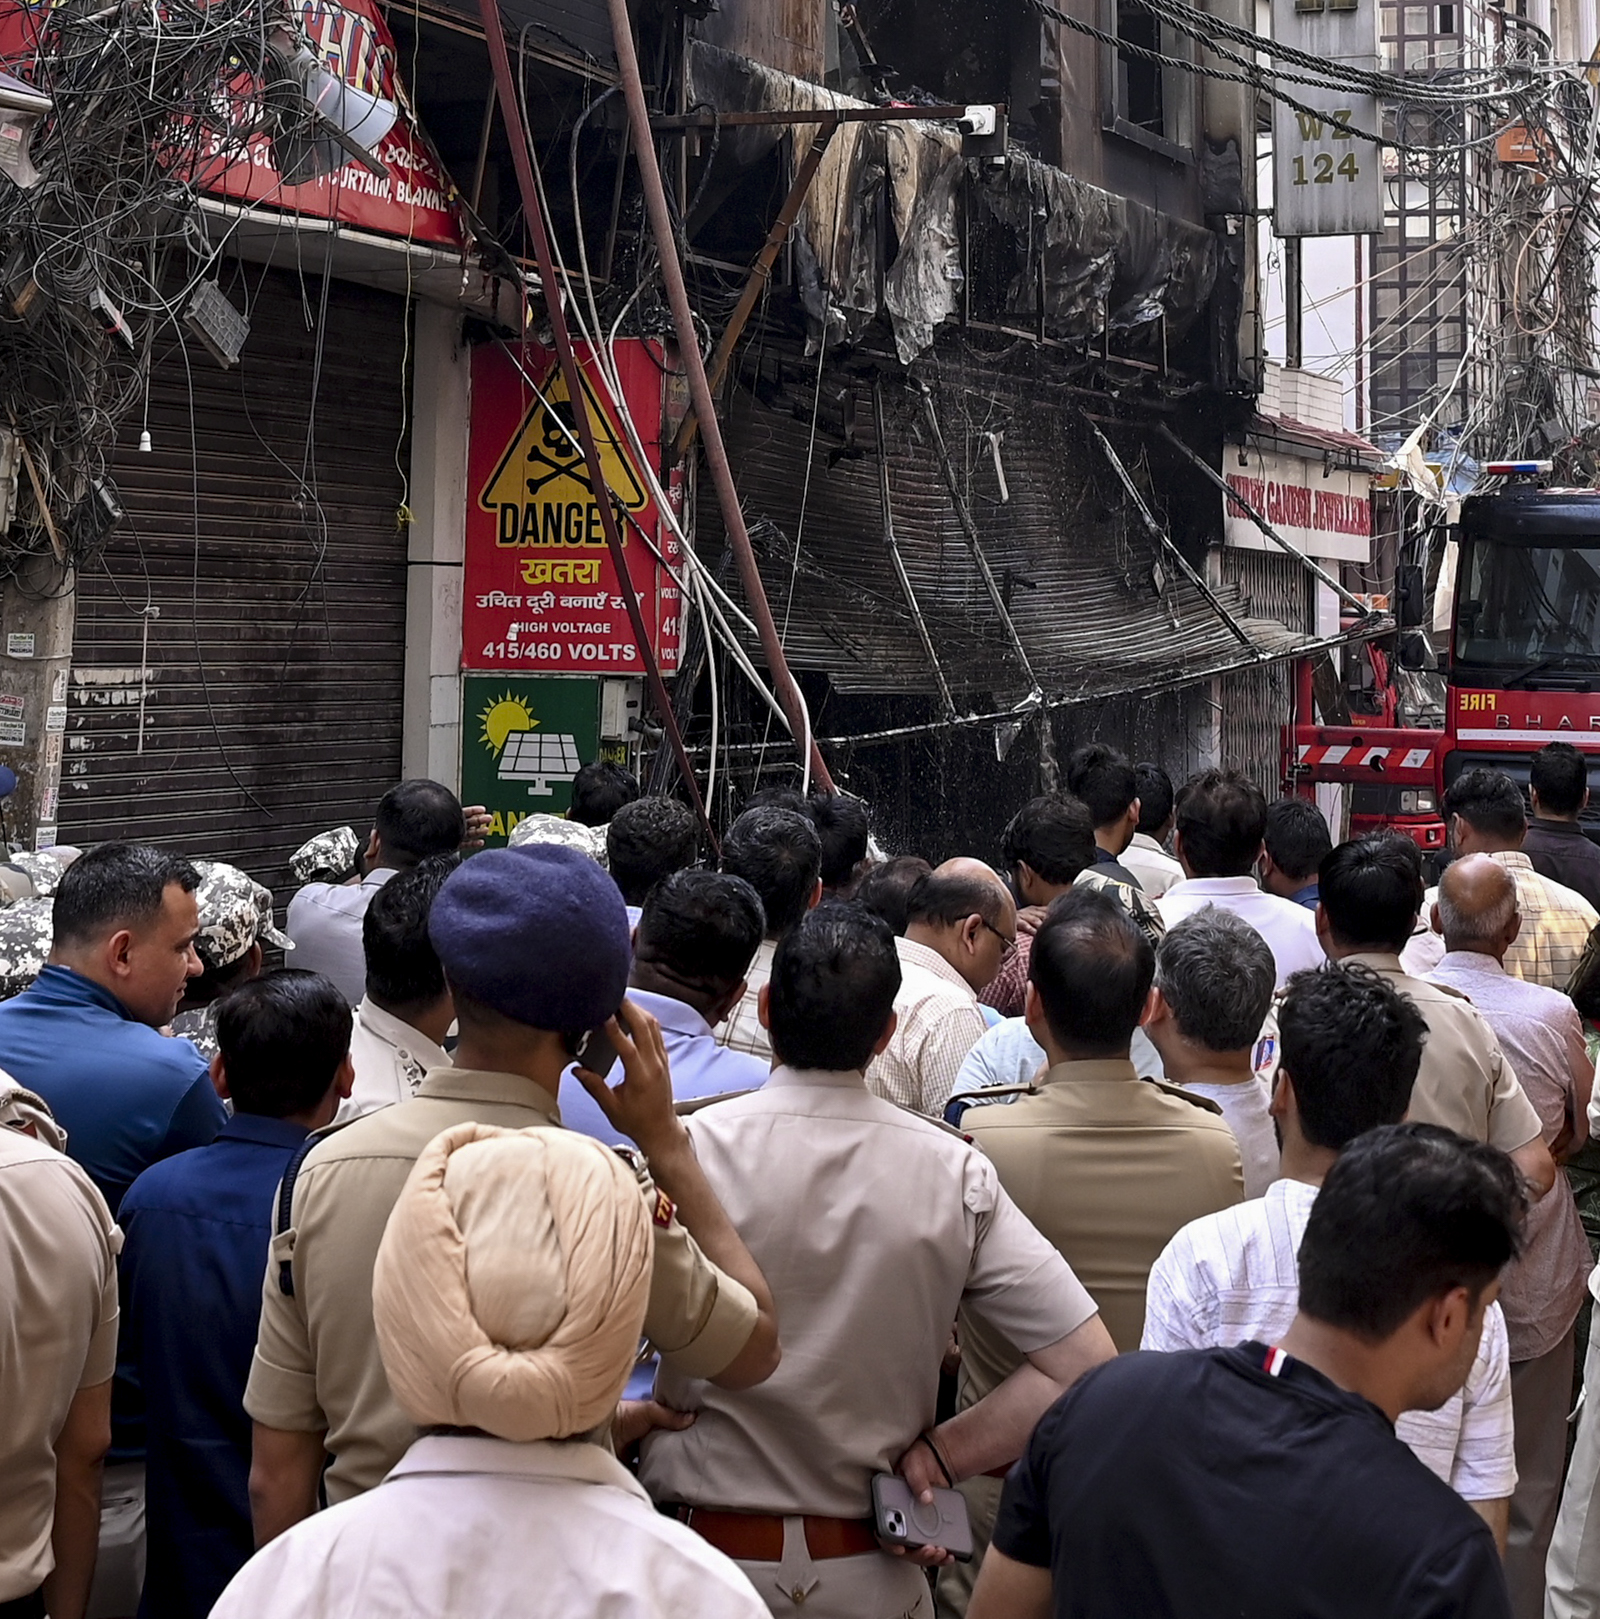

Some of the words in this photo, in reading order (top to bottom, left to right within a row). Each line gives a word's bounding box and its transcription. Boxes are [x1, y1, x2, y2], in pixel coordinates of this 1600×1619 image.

[1291, 153, 1360, 189] 124
[1267, 480, 1312, 529] GANESH
[520, 558, 602, 585] खतरा
[475, 590, 522, 610] उचित
[526, 590, 555, 615] दूरी
[515, 622, 548, 634] HIGH
[551, 622, 612, 634] VOLTAGE
[482, 642, 562, 660] 415/460
[568, 643, 637, 661] VOLTS
